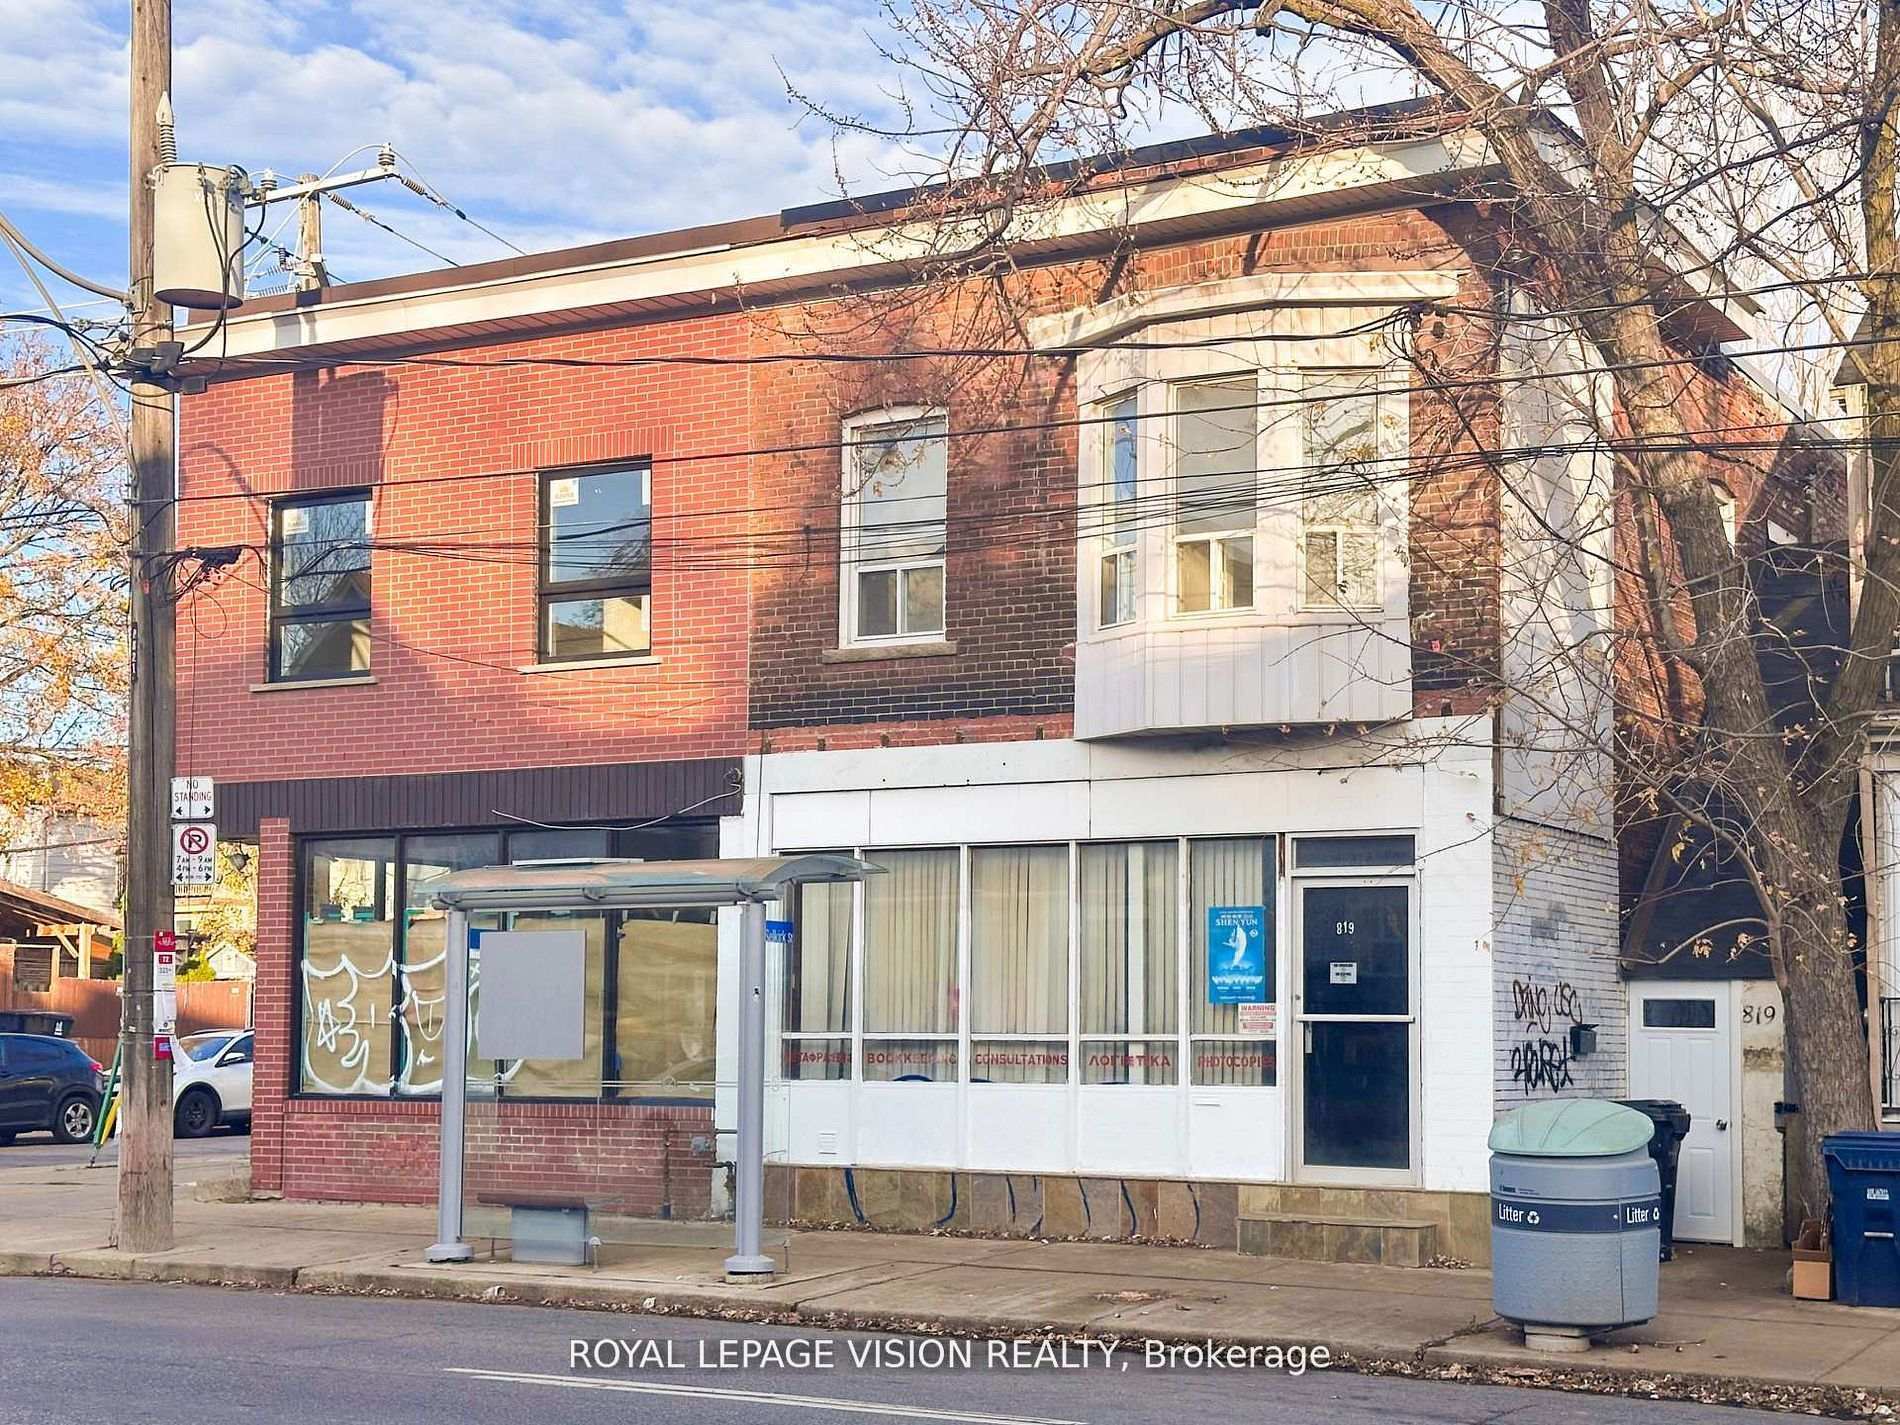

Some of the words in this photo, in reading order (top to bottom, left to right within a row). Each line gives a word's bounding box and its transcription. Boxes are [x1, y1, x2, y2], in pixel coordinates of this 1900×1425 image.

[186, 780, 199, 789] NO
[174, 792, 212, 801] STANDING
[1336, 920, 1355, 935] 819
[1742, 1005, 1776, 1025] 819
[975, 1053, 1068, 1066] CONSULTATIONS
[1498, 1203, 1524, 1222] Litter
[1626, 1207, 1649, 1223] Litter
